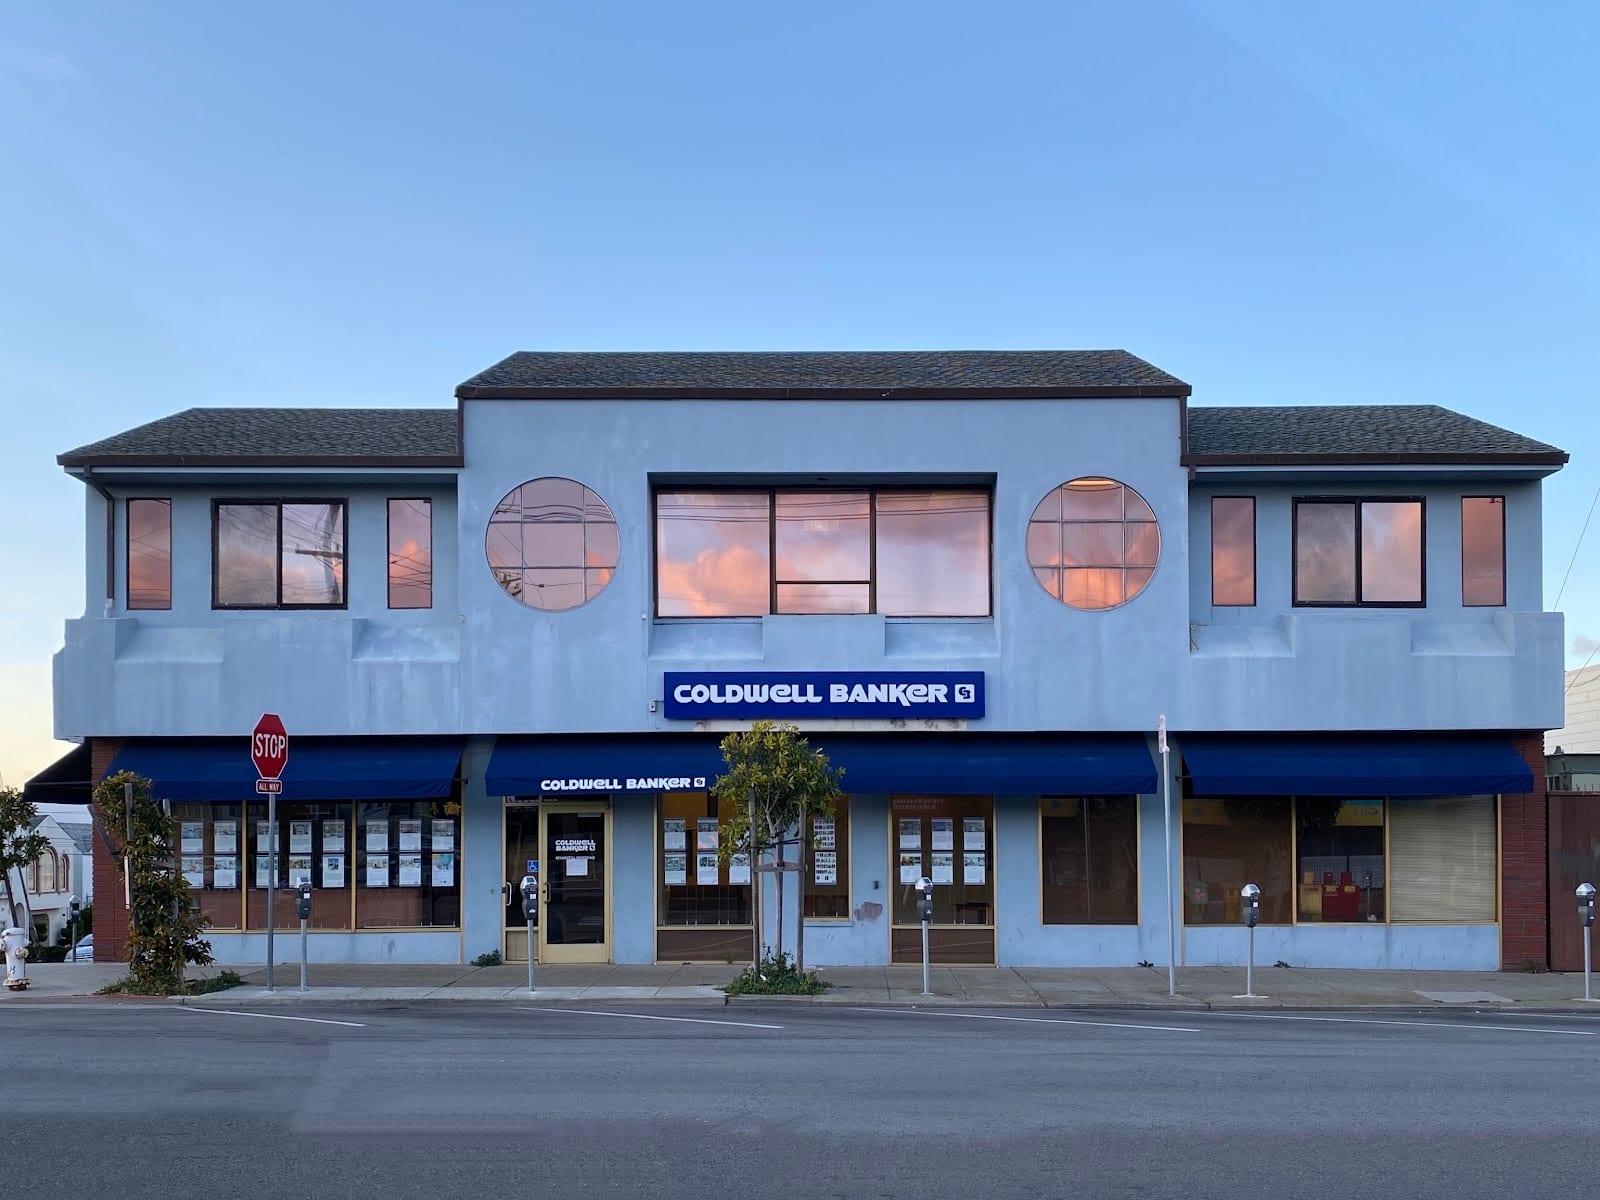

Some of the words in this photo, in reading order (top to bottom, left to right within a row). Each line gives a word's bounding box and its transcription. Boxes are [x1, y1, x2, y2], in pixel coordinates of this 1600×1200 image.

[673, 684, 823, 704] COLDWELL
[829, 684, 949, 707] BANKER
[255, 733, 286, 758] STOP
[259, 782, 268, 791] ALL
[269, 783, 279, 791] WAY
[540, 778, 622, 791] COLDWELL
[626, 777, 691, 791] BANKER
